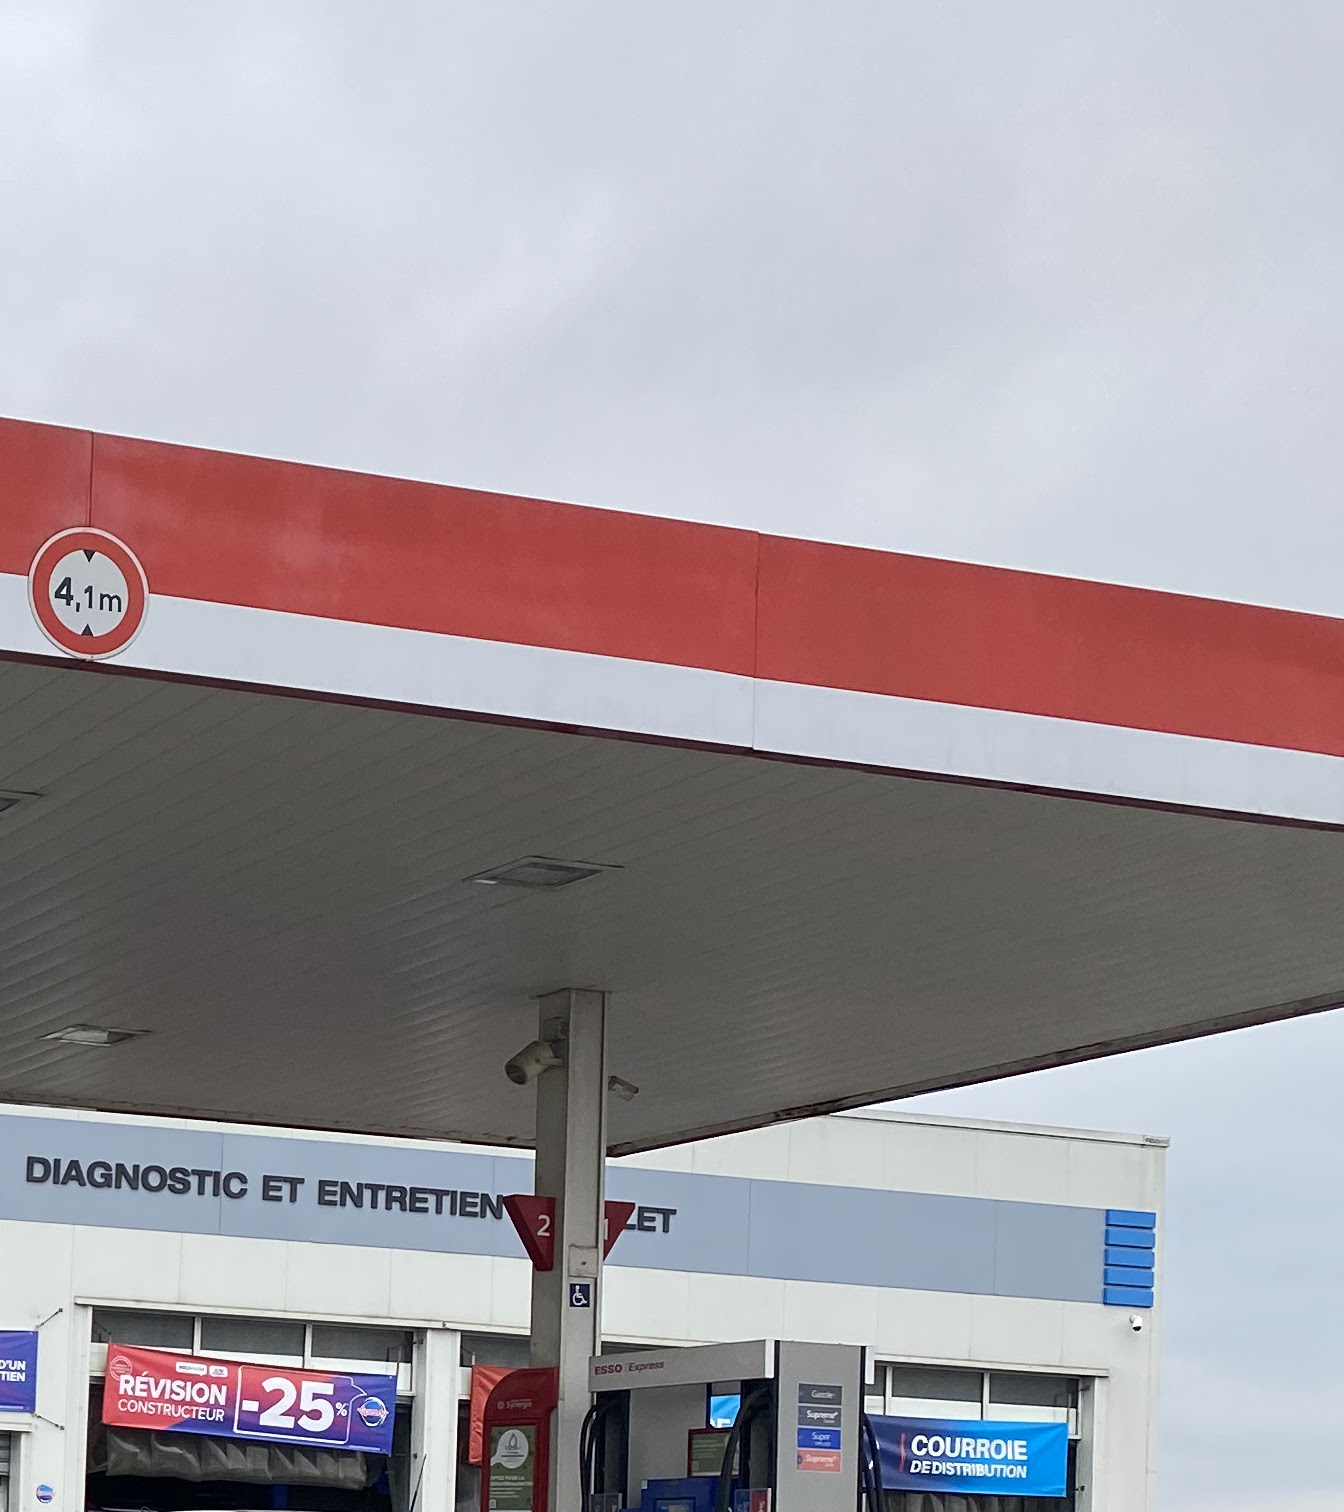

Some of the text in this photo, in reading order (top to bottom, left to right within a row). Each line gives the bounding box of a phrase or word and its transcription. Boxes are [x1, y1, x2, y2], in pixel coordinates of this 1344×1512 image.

[54, 576, 122, 613] 4,1m
[25, 1155, 249, 1200] DIAGNOSTIC
[261, 1175, 304, 1204] ET
[317, 1179, 504, 1221] ENTRETIEN
[537, 1214, 551, 1237] 2
[594, 1360, 666, 1376] ESSO Express
[118, 1371, 228, 1406] RÉVISION
[118, 1399, 225, 1422] CONSTRUCTEUR
[910, 1434, 1028, 1461] COURROIE
